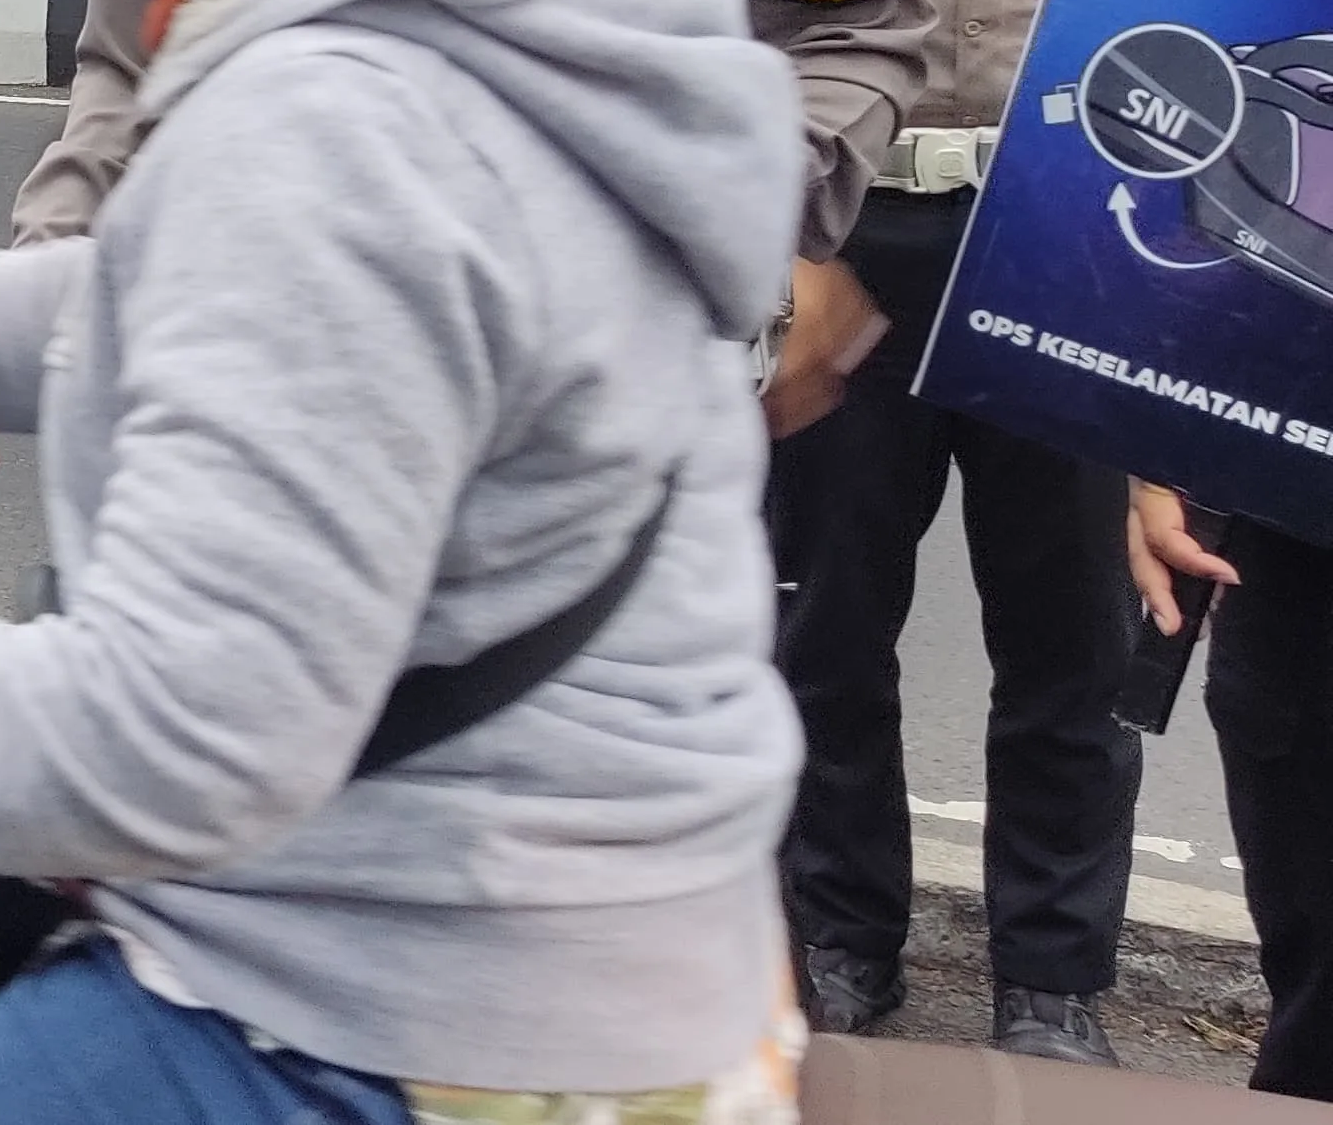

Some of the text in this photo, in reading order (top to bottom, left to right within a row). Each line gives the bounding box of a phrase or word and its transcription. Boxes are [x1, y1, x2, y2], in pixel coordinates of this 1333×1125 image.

[1119, 88, 1191, 141] SNI
[1233, 229, 1268, 255] SNI
[968, 309, 1034, 348] OPS
[1036, 331, 1281, 435] KESELAMATAN
